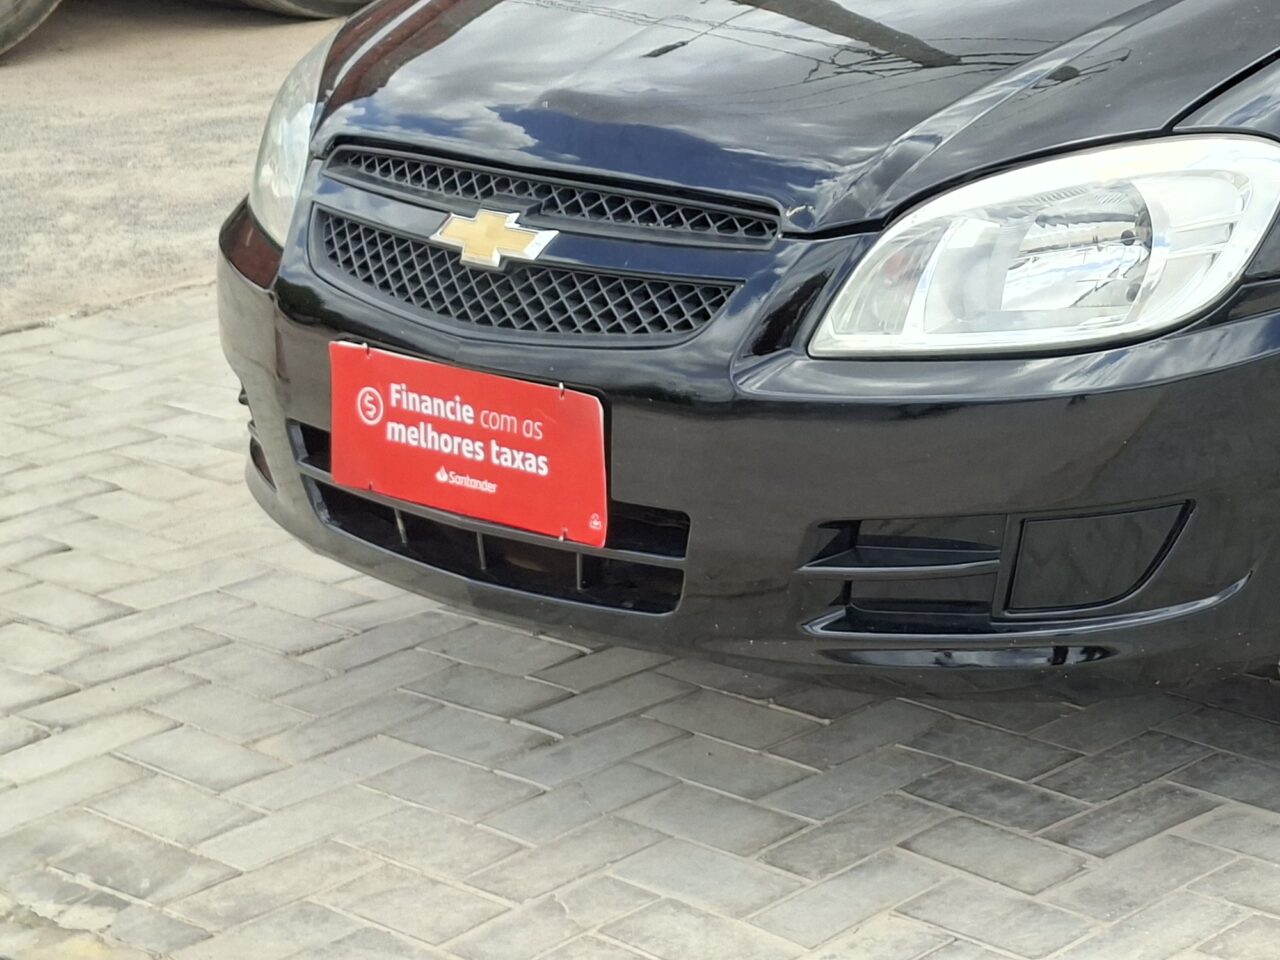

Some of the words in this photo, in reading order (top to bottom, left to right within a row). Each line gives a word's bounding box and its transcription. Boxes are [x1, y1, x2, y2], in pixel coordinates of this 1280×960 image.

[389, 383, 475, 425] Financie
[480, 407, 518, 435] com
[522, 417, 544, 441] as
[386, 420, 485, 462] melhores
[490, 439, 549, 476] taxas
[447, 470, 498, 494] Santander
